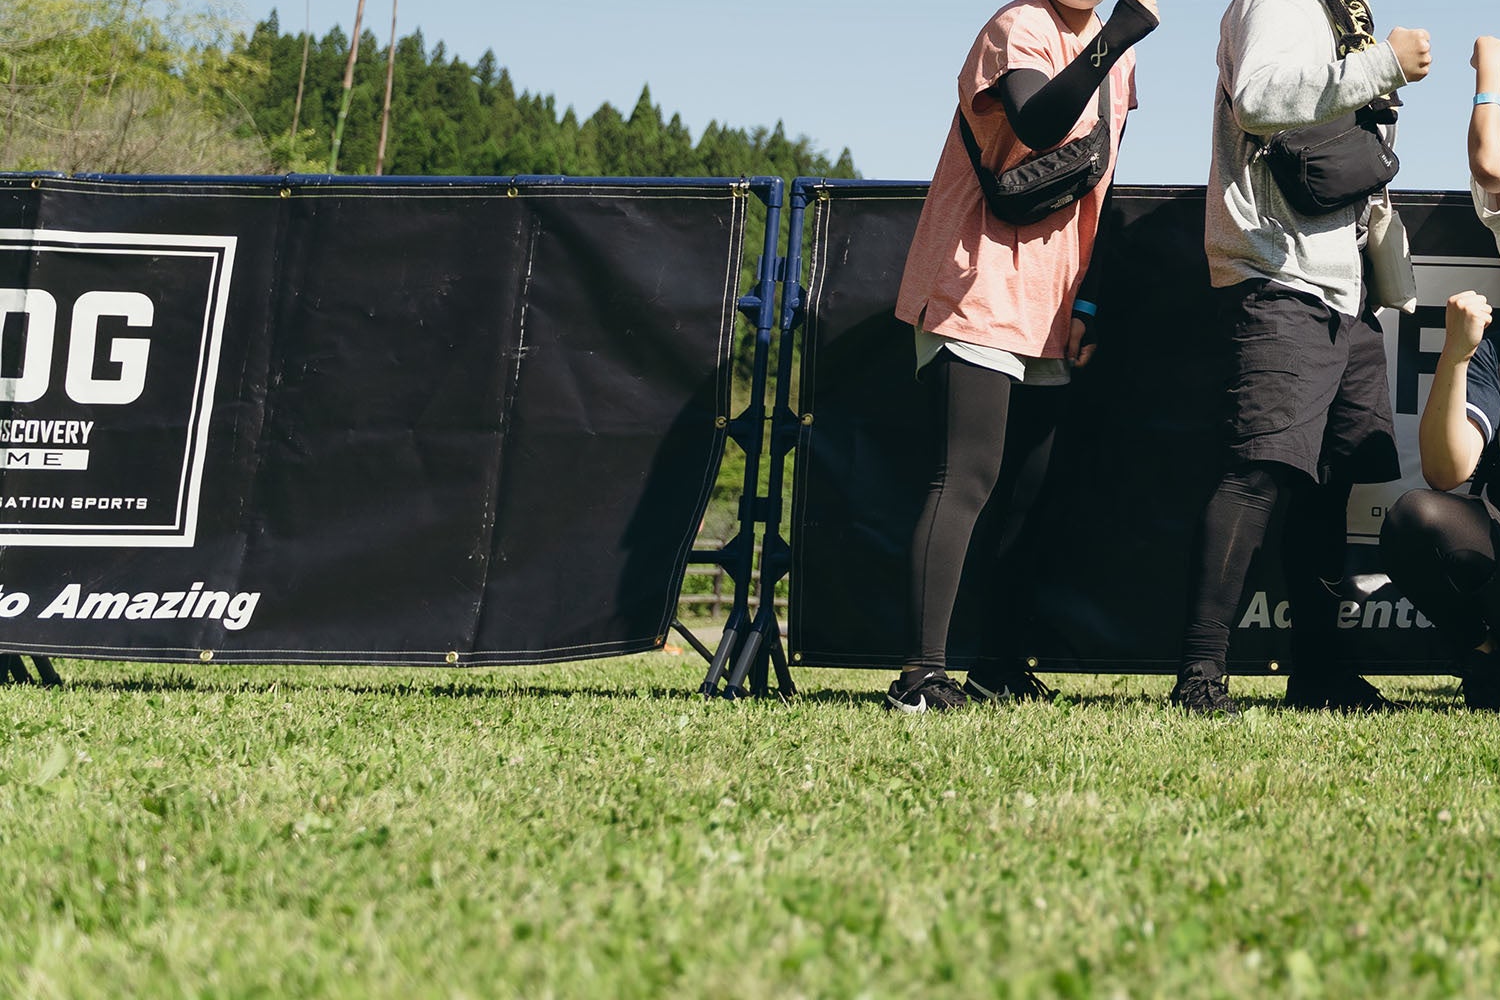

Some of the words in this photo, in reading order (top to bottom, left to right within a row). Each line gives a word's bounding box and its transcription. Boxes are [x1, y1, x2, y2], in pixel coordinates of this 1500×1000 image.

[0, 497, 64, 509] ATION
[71, 498, 148, 509] SPORTS
[37, 582, 261, 630] Amazing
